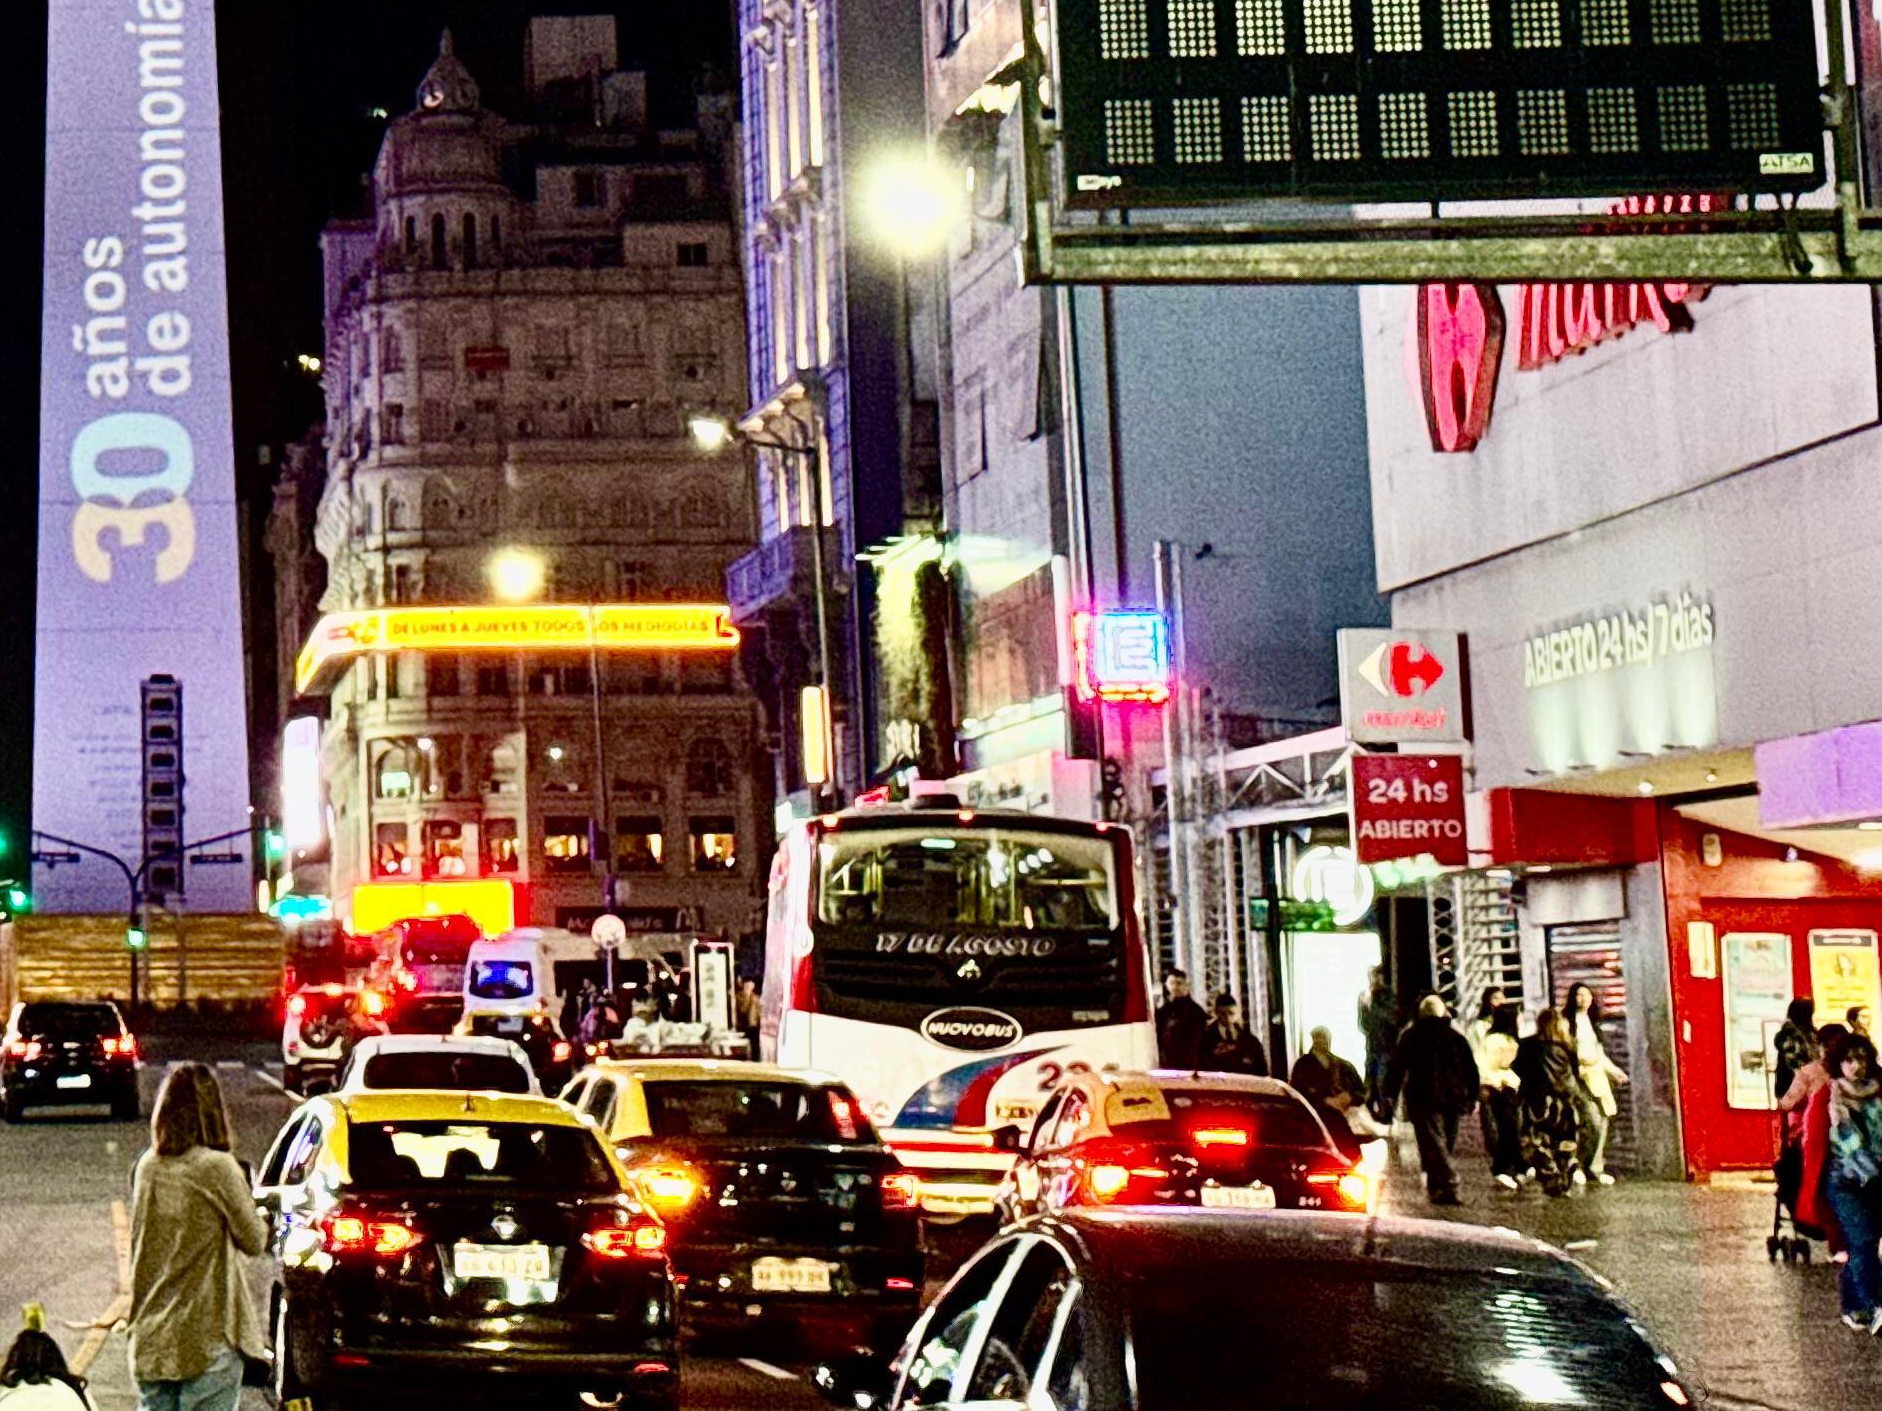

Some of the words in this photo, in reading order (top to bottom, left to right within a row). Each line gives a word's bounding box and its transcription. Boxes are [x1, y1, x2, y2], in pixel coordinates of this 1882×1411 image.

[73, 235, 128, 399] años
[134, 311, 192, 397] de
[69, 410, 197, 585] 30
[1524, 622, 1598, 688] ABIERTO
[1597, 614, 1623, 670] 24
[1670, 591, 1714, 653] días
[1358, 818, 1463, 840] ABIERTO
[1367, 777, 1408, 804] 24
[1412, 777, 1449, 803] hs
[927, 1021, 1015, 1039] NUOVOBUS
